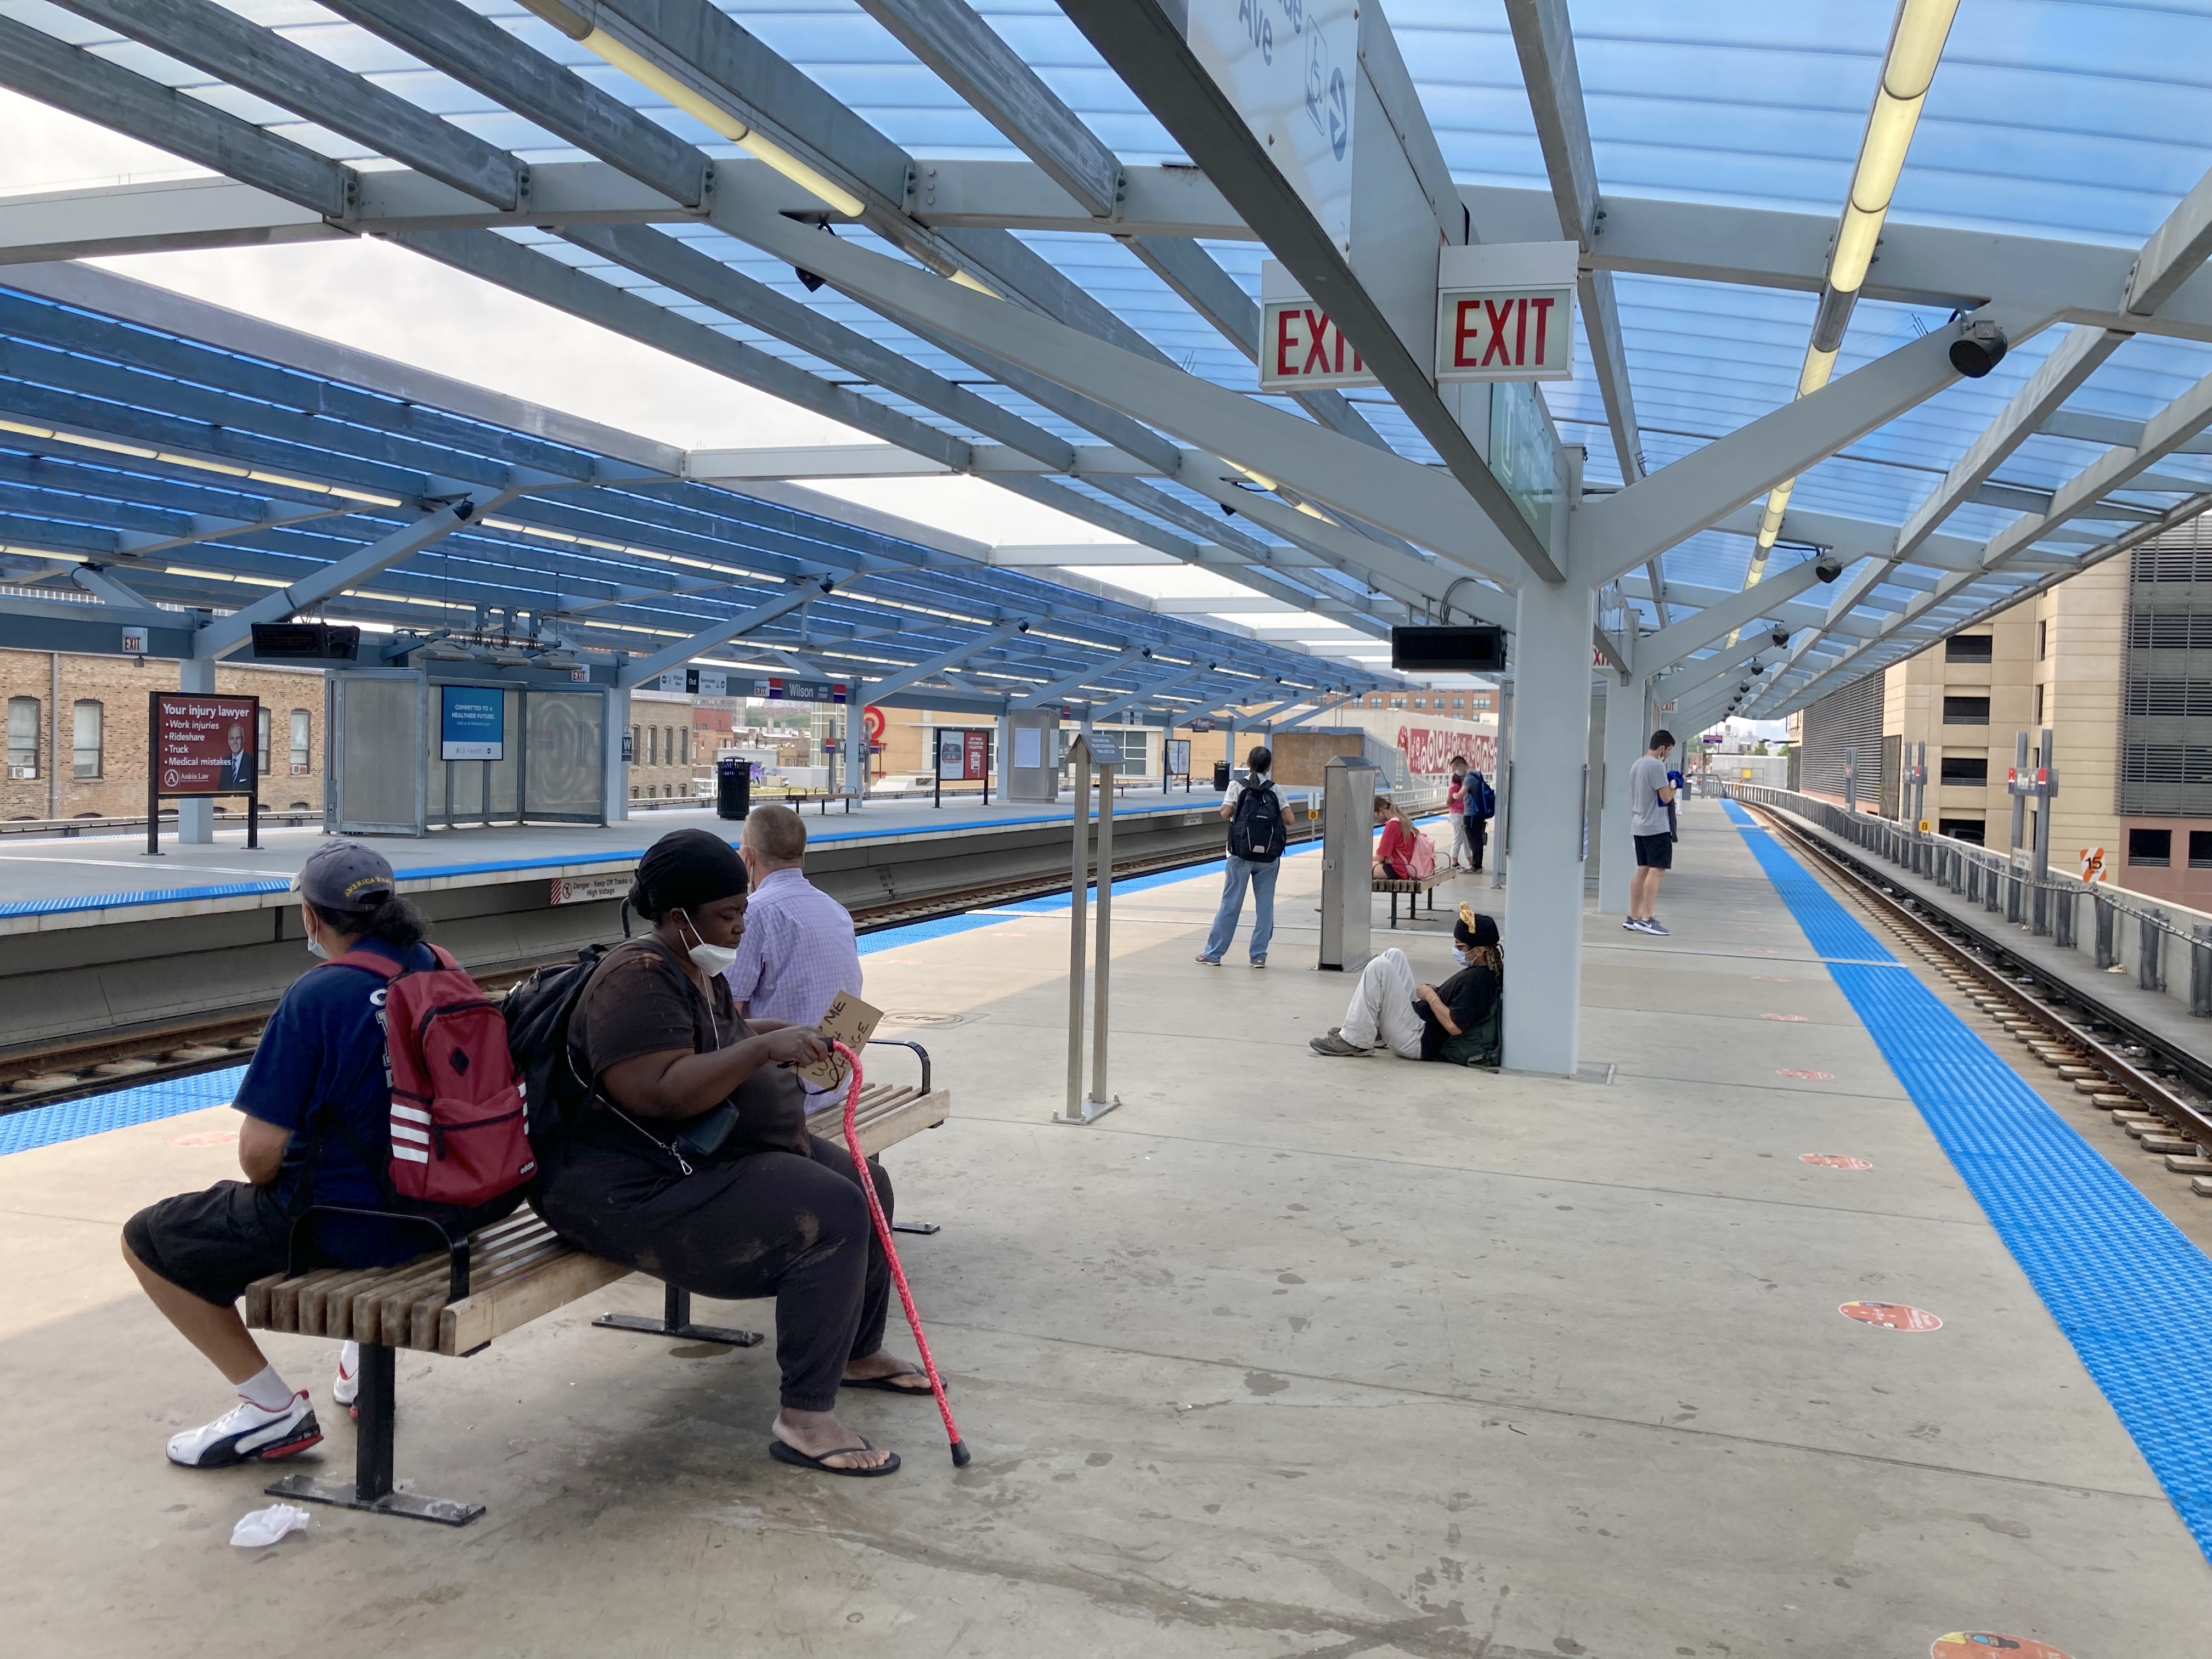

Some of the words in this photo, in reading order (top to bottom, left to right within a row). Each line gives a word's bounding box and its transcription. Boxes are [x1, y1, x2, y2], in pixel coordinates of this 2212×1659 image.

[1239, 0, 1272, 66] Ave
[1454, 298, 1555, 368] EXIT
[1278, 310, 1363, 376] EXI
[125, 637, 140, 651] EXIT
[573, 671, 585, 681] EXIT
[756, 686, 767, 695] EXIT
[789, 684, 814, 698] Wilson
[163, 703, 186, 715] Your
[189, 704, 216, 719] injury
[218, 705, 250, 720] lawyer
[170, 720, 189, 729] Work
[192, 720, 219, 731] injuries
[169, 732, 205, 741] Rideshare
[168, 744, 189, 753] Truck
[623, 738, 631, 751] W
[168, 757, 198, 766] Medical
[200, 758, 231, 766] mistakes
[1921, 822, 1928, 831] 8
[2085, 856, 2102, 870] 15
[573, 882, 590, 890] Danger
[587, 889, 597, 898] High
[824, 1001, 846, 1025] ME
[829, 1022, 869, 1082] CHNGE
[521, 1161, 534, 1174] adidas
